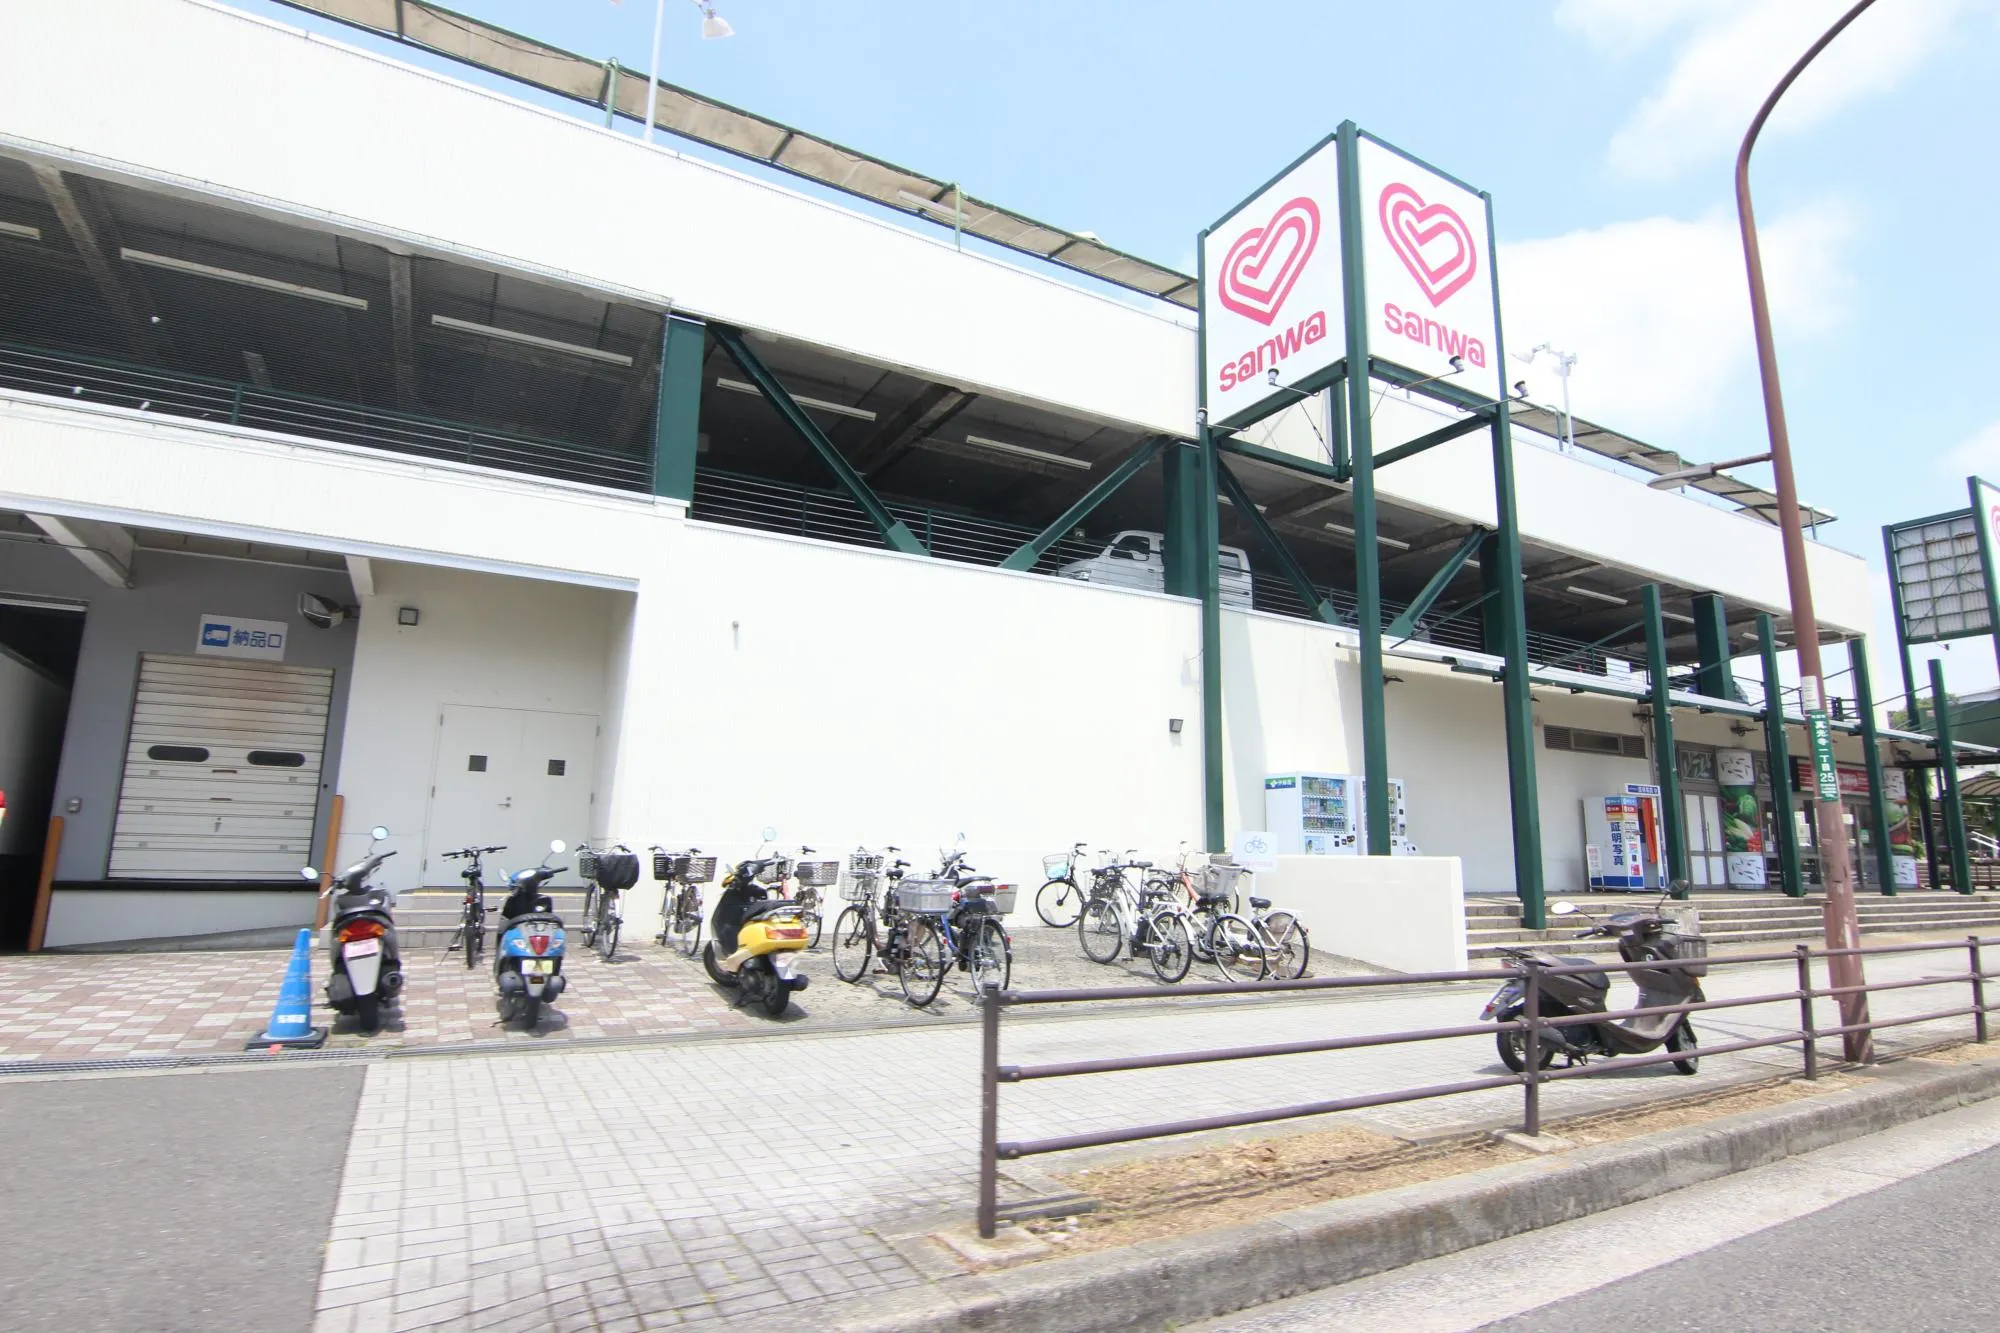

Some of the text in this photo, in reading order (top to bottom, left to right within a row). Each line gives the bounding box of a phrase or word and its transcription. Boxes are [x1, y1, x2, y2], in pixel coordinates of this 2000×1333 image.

[1219, 310, 1326, 392] sanwa
[1384, 302, 1486, 368] sanwa
[233, 629, 282, 648] 納品口
[1820, 772, 1835, 782] 25
[1610, 821, 1624, 866] 証明写真
